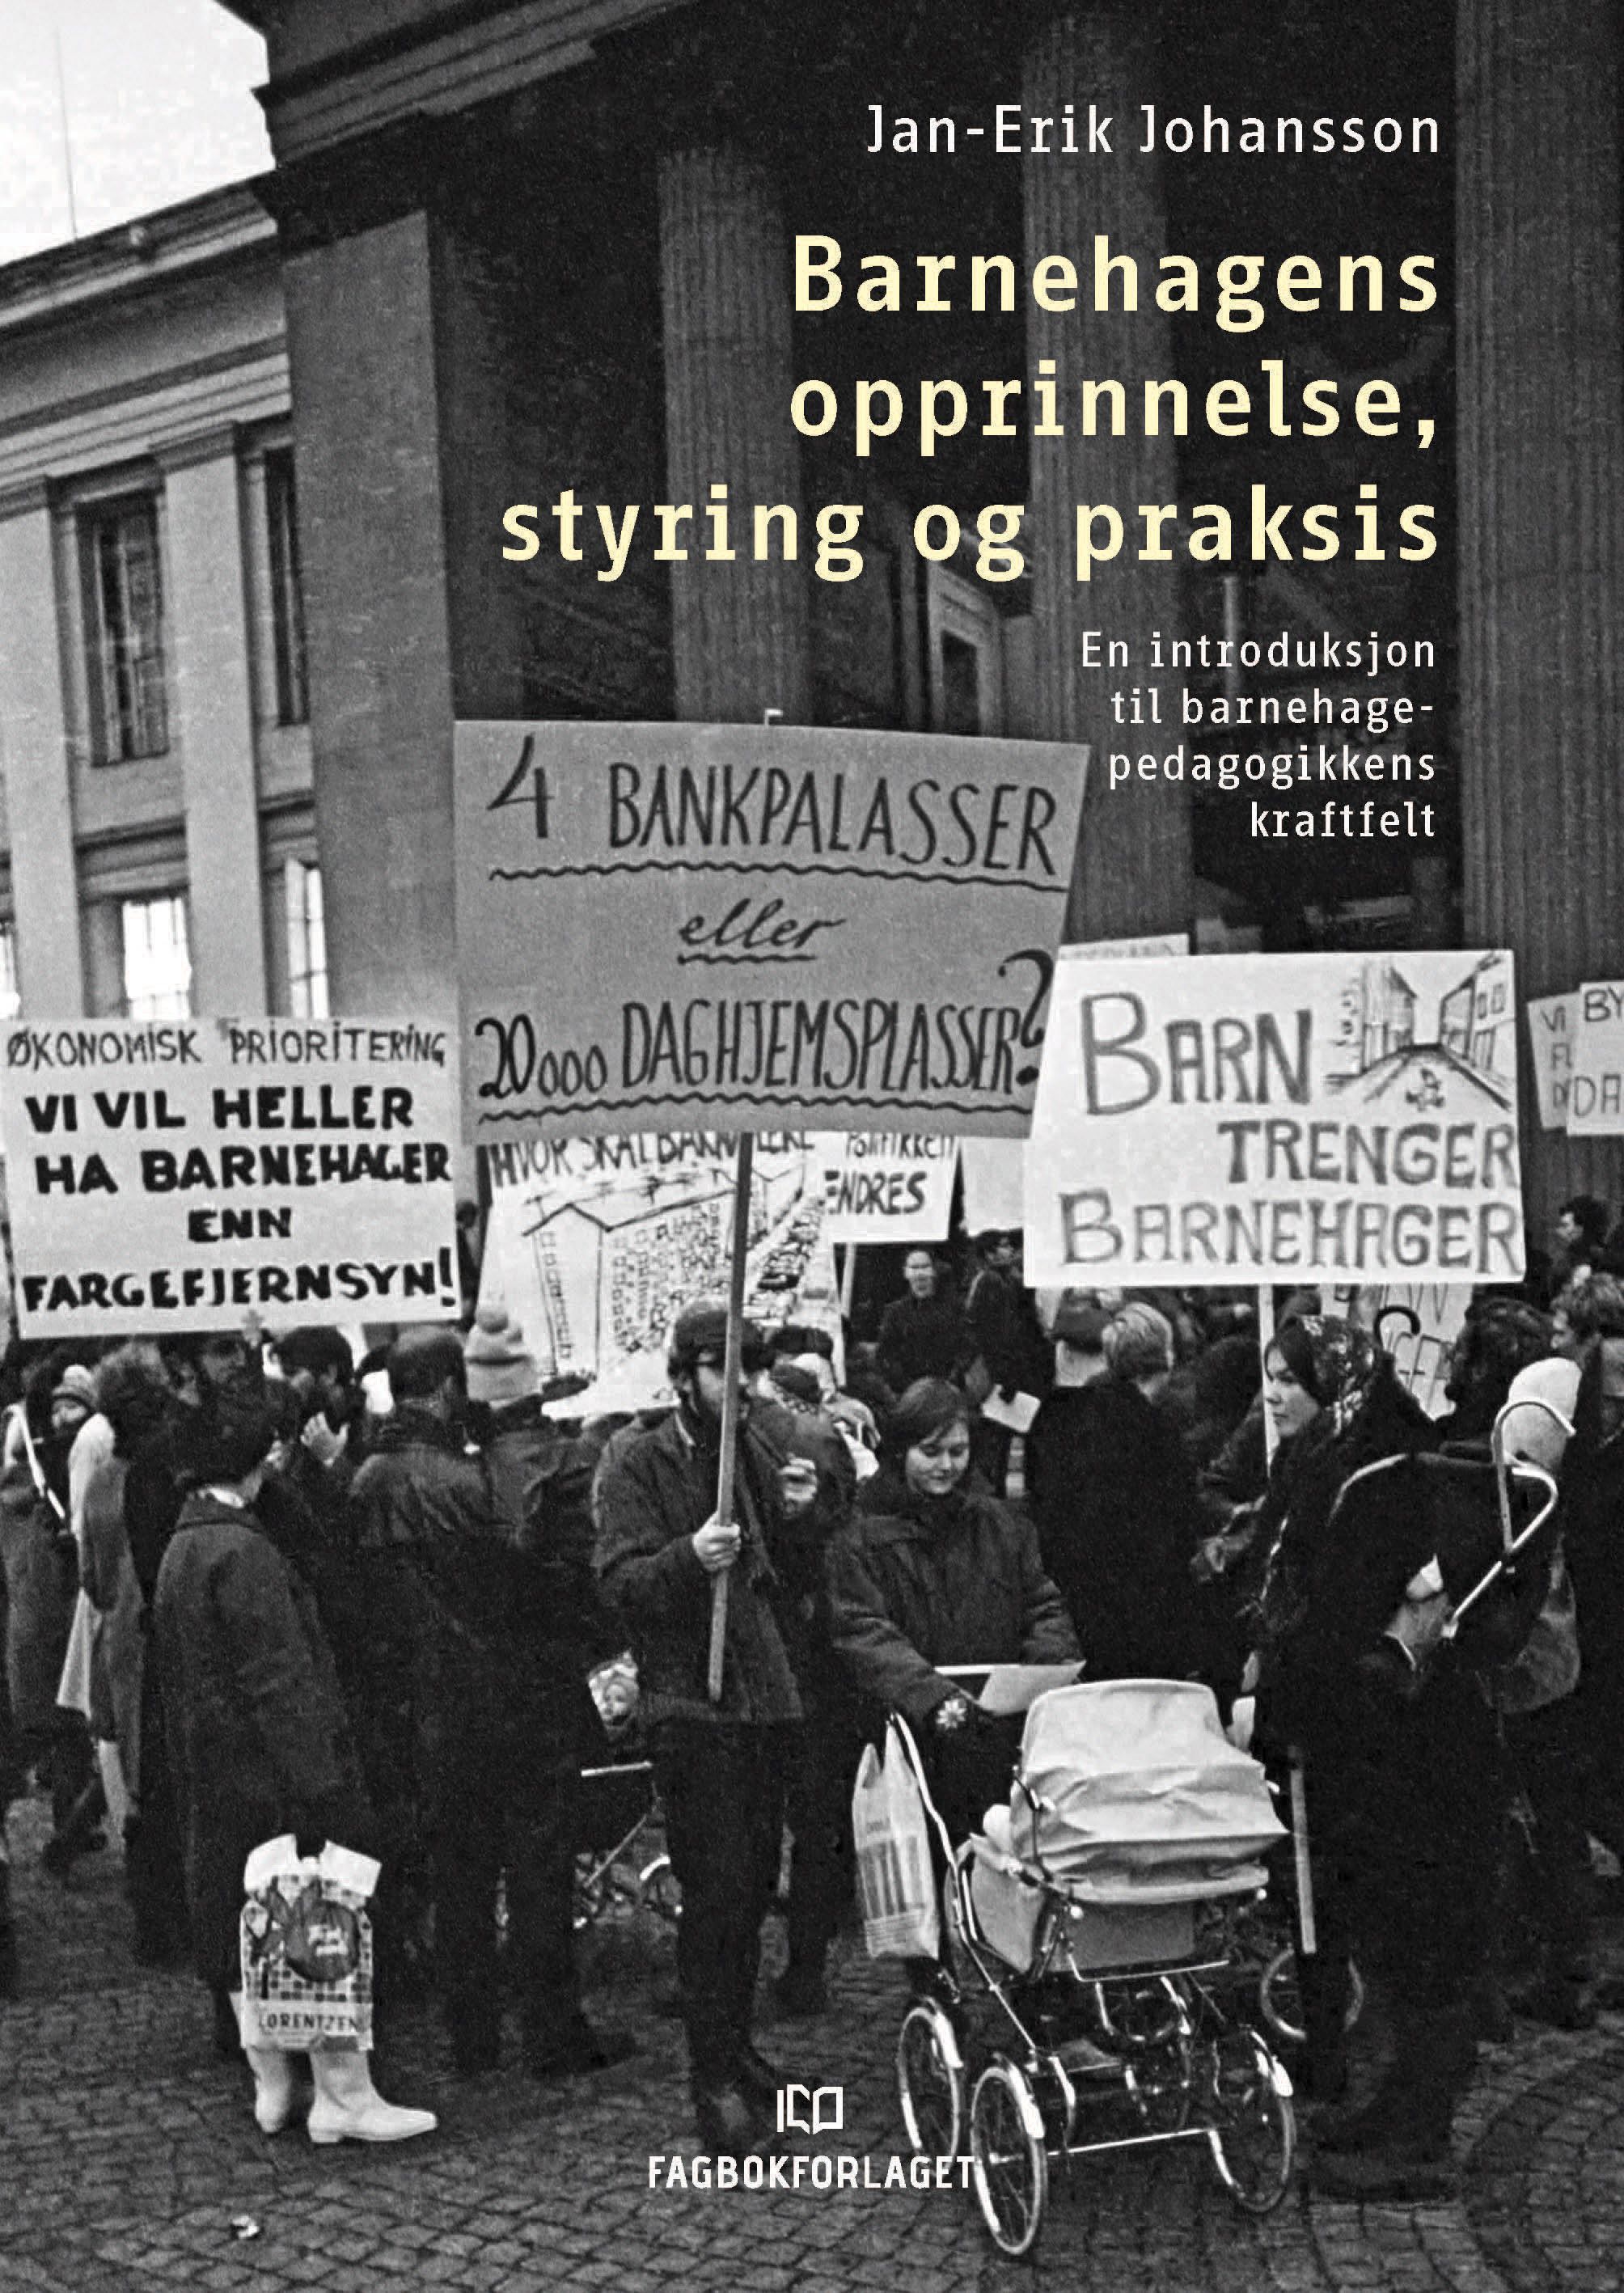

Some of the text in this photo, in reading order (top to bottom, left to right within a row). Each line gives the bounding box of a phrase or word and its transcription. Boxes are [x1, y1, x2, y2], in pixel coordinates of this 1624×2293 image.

[486, 734, 1057, 876] 4 BANKPALASSER
[678, 898, 846, 949] eller
[7, 1022, 446, 1071] ØKONOMISK PRIORITERING
[1081, 992, 1313, 1115] BARN
[24, 1085, 413, 1133] VI VIL HELLER
[35, 1142, 452, 1195] HA BARNEHAGER
[1217, 1118, 1517, 1189] TRENGER
[188, 1208, 292, 1243] ENN
[1058, 1187, 1522, 1275] BARNEHAGER
[22, 1247, 456, 1312] FARGEFJERNSYN!
